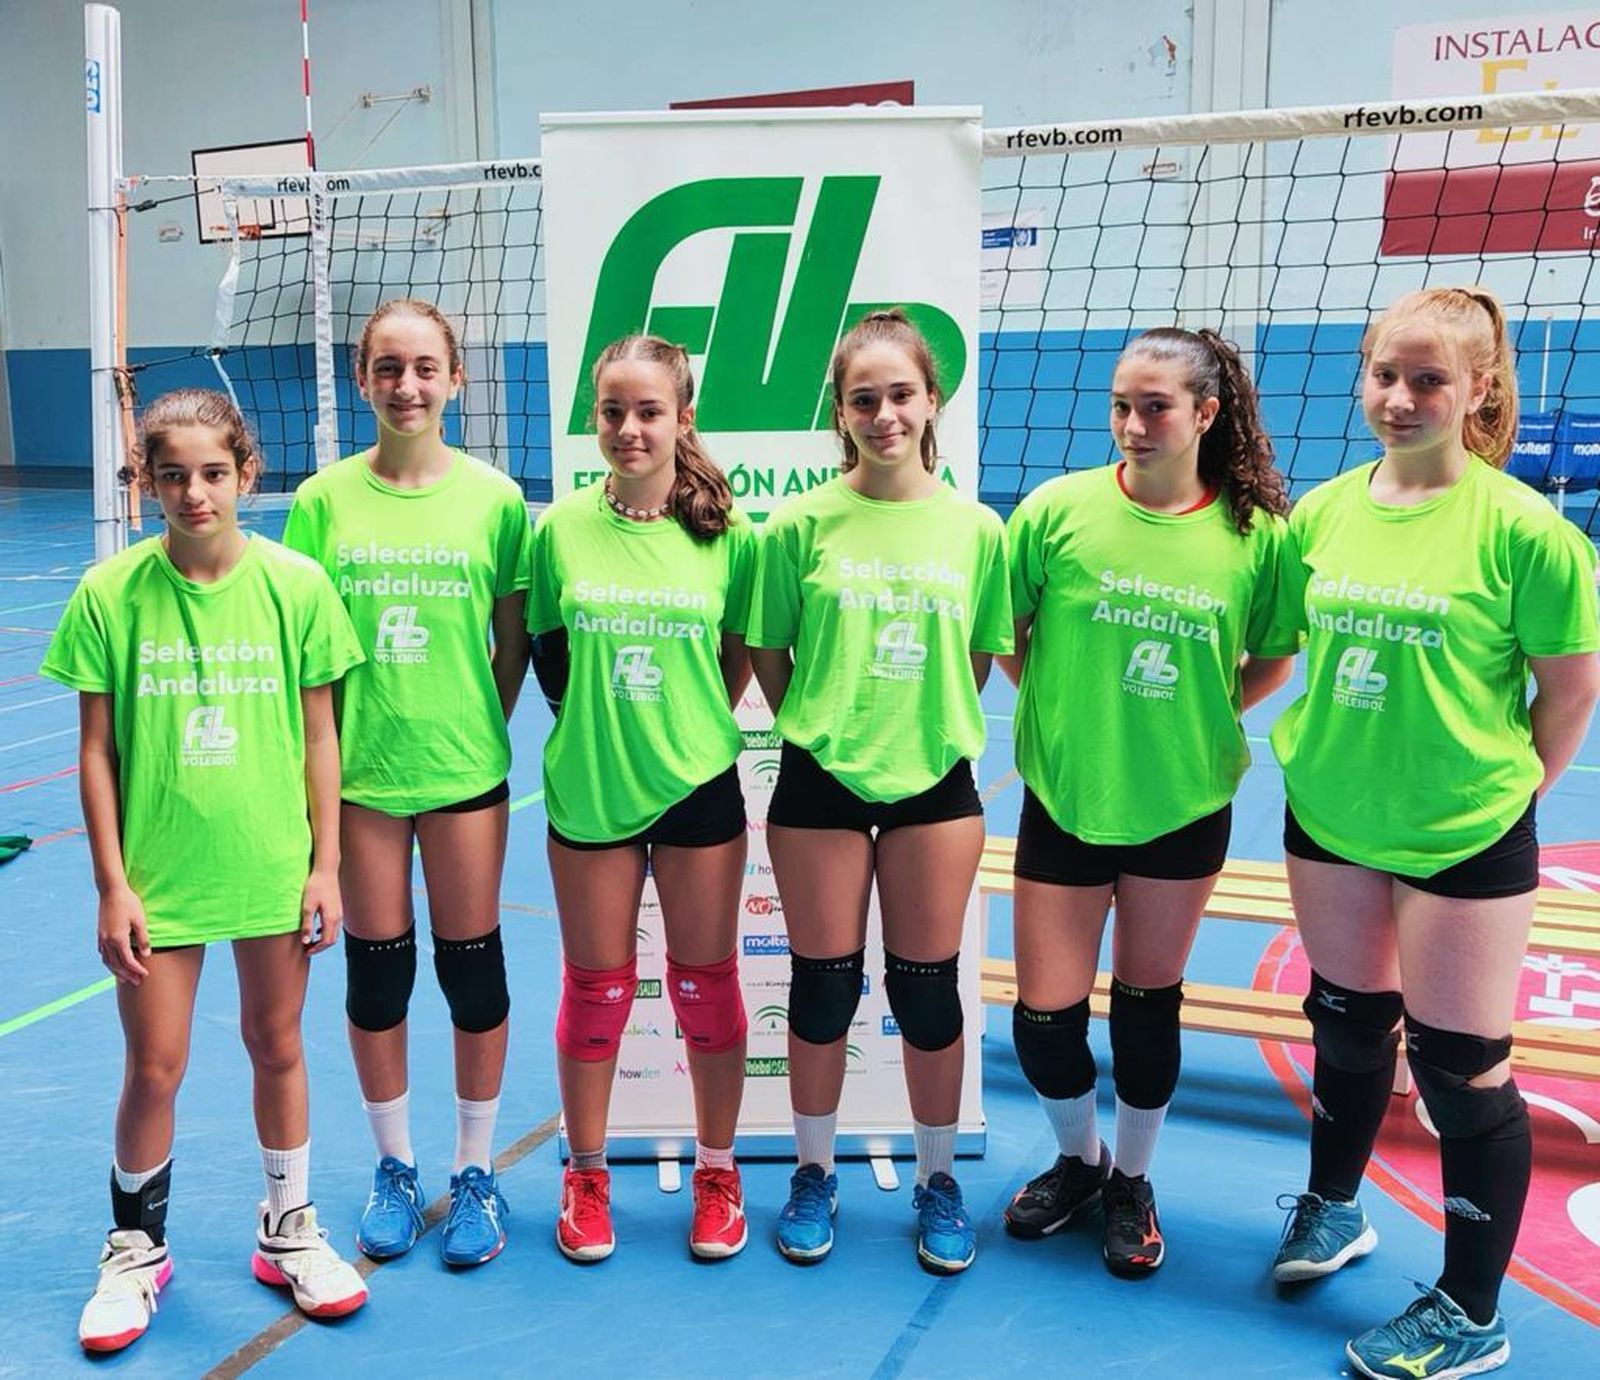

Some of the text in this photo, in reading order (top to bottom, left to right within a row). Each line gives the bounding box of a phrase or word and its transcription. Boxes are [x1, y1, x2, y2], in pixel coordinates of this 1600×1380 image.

[1344, 104, 1483, 128] rfevb.com
[1006, 127, 1123, 149] rfevb.com
[277, 176, 350, 193] rfevom
[483, 163, 542, 181] rfevb.c
[336, 540, 470, 568] Selección
[339, 570, 472, 598] Andaluza
[575, 579, 708, 611] Selección
[1099, 569, 1227, 617] Selección
[839, 586, 966, 621] Andaluza
[574, 610, 706, 639] Andaluza
[1307, 603, 1445, 649] Andaluza
[138, 636, 276, 665] Selección
[136, 669, 279, 698] Andaluza
[1121, 682, 1177, 701] VOLEIBOL
[1332, 691, 1386, 711] VOLEIBOL
[745, 937, 790, 948] molte
